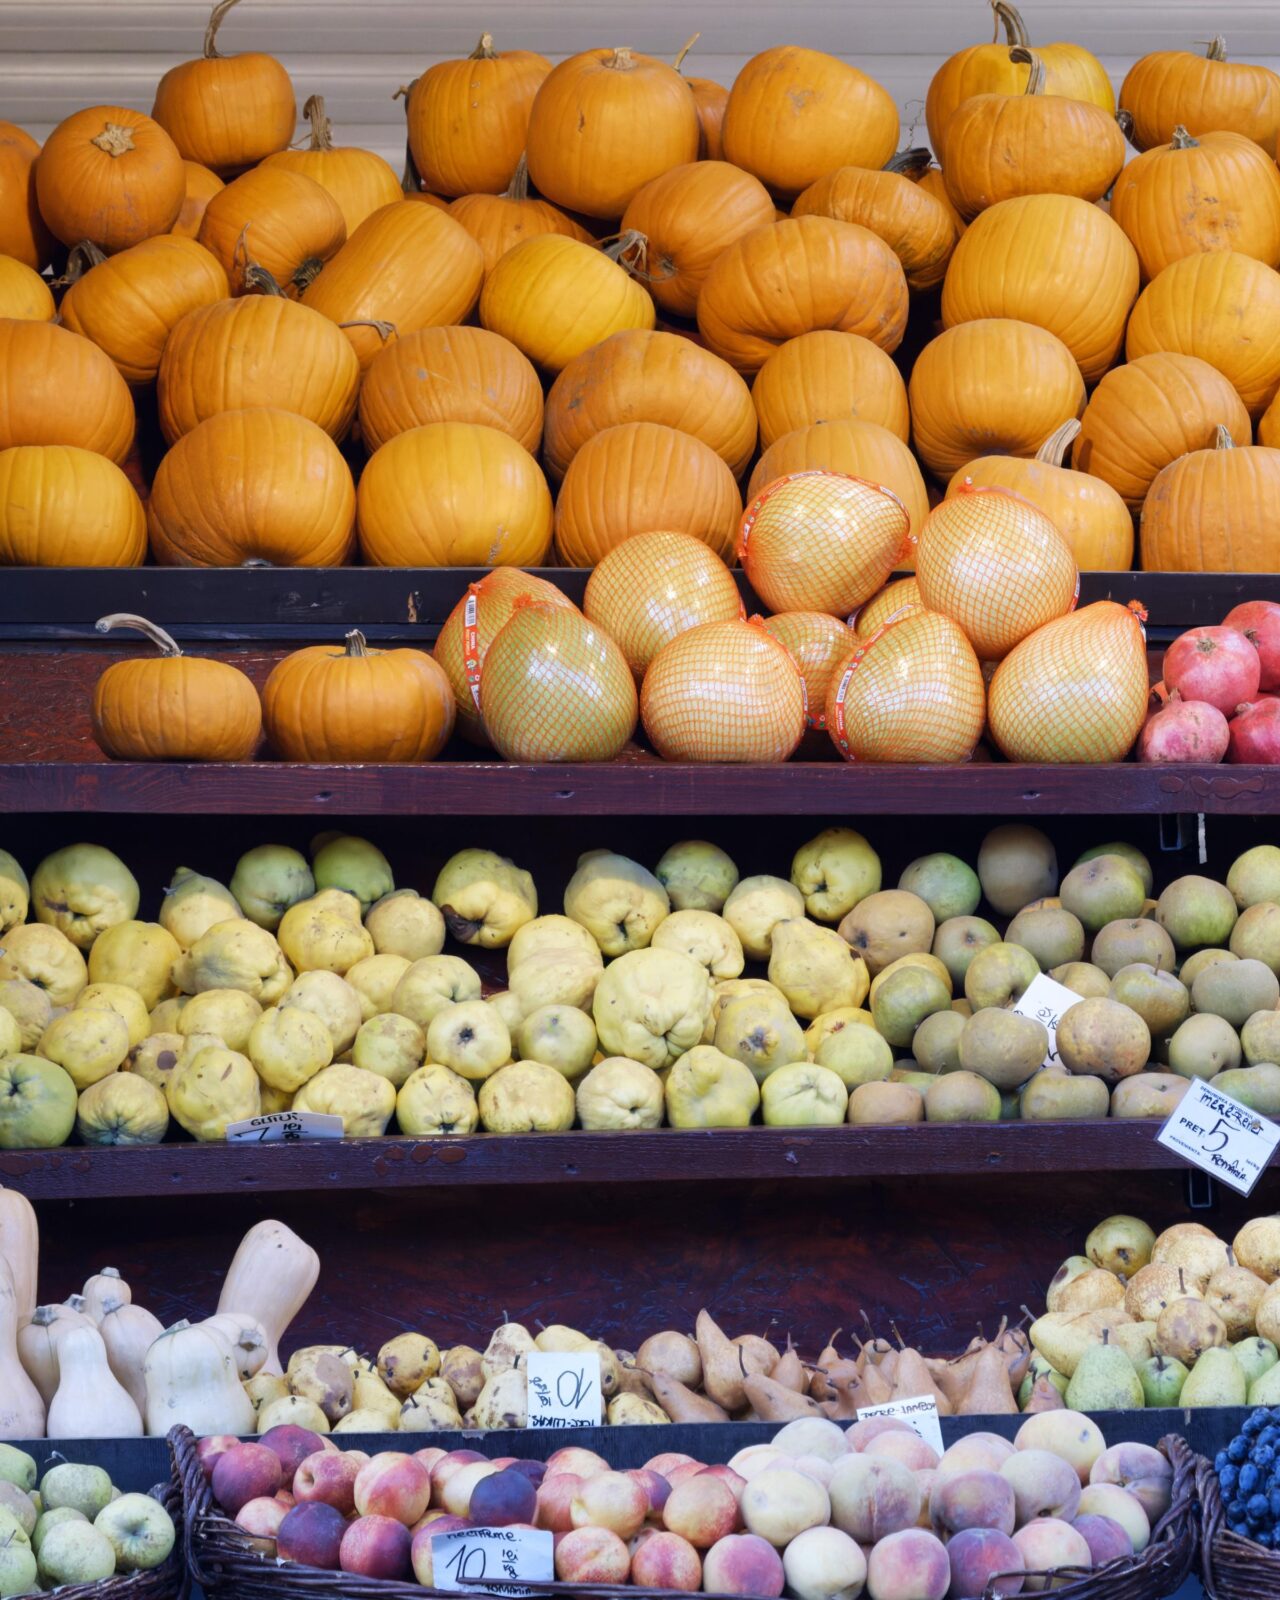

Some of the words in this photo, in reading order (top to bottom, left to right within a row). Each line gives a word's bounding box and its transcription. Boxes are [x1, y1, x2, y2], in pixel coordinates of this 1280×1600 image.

[1201, 1118, 1241, 1152] 5
[557, 1367, 593, 1410] 10
[445, 1544, 486, 1581] 10
